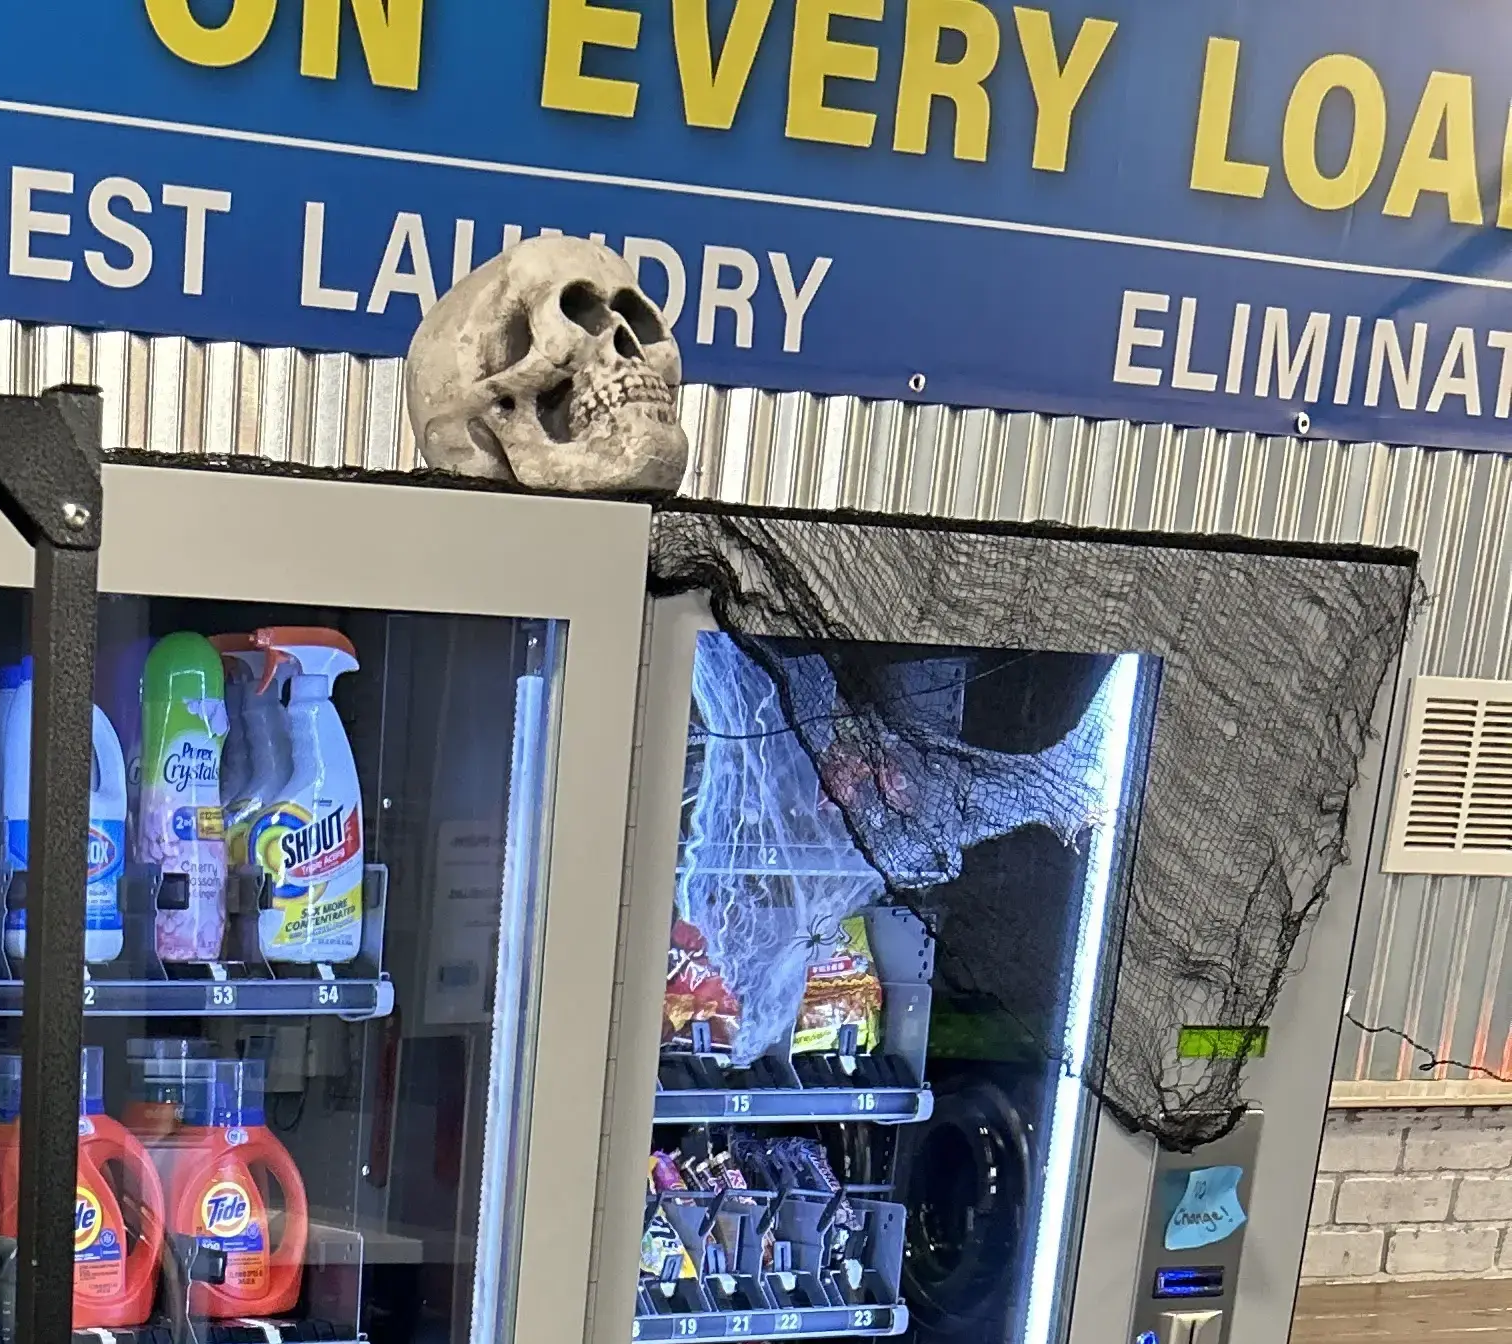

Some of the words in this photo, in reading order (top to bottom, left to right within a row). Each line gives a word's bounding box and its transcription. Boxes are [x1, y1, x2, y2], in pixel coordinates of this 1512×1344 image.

[541, 0, 1118, 172] EVERY
[1190, 36, 1512, 230] LOA
[300, 201, 833, 353] LADRY
[282, 804, 344, 869] SHOUT
[285, 905, 356, 932] CONENTRATED
[83, 986, 95, 1005] 2
[213, 986, 233, 1005] 53
[319, 985, 338, 1004] 54
[732, 1096, 749, 1112] 15
[858, 1094, 875, 1110] 16
[75, 1202, 96, 1230] de
[207, 1195, 247, 1228] Tide
[680, 1318, 697, 1335] 19
[733, 1316, 749, 1332] 21
[780, 1314, 798, 1330] 22
[854, 1310, 872, 1326] 23
